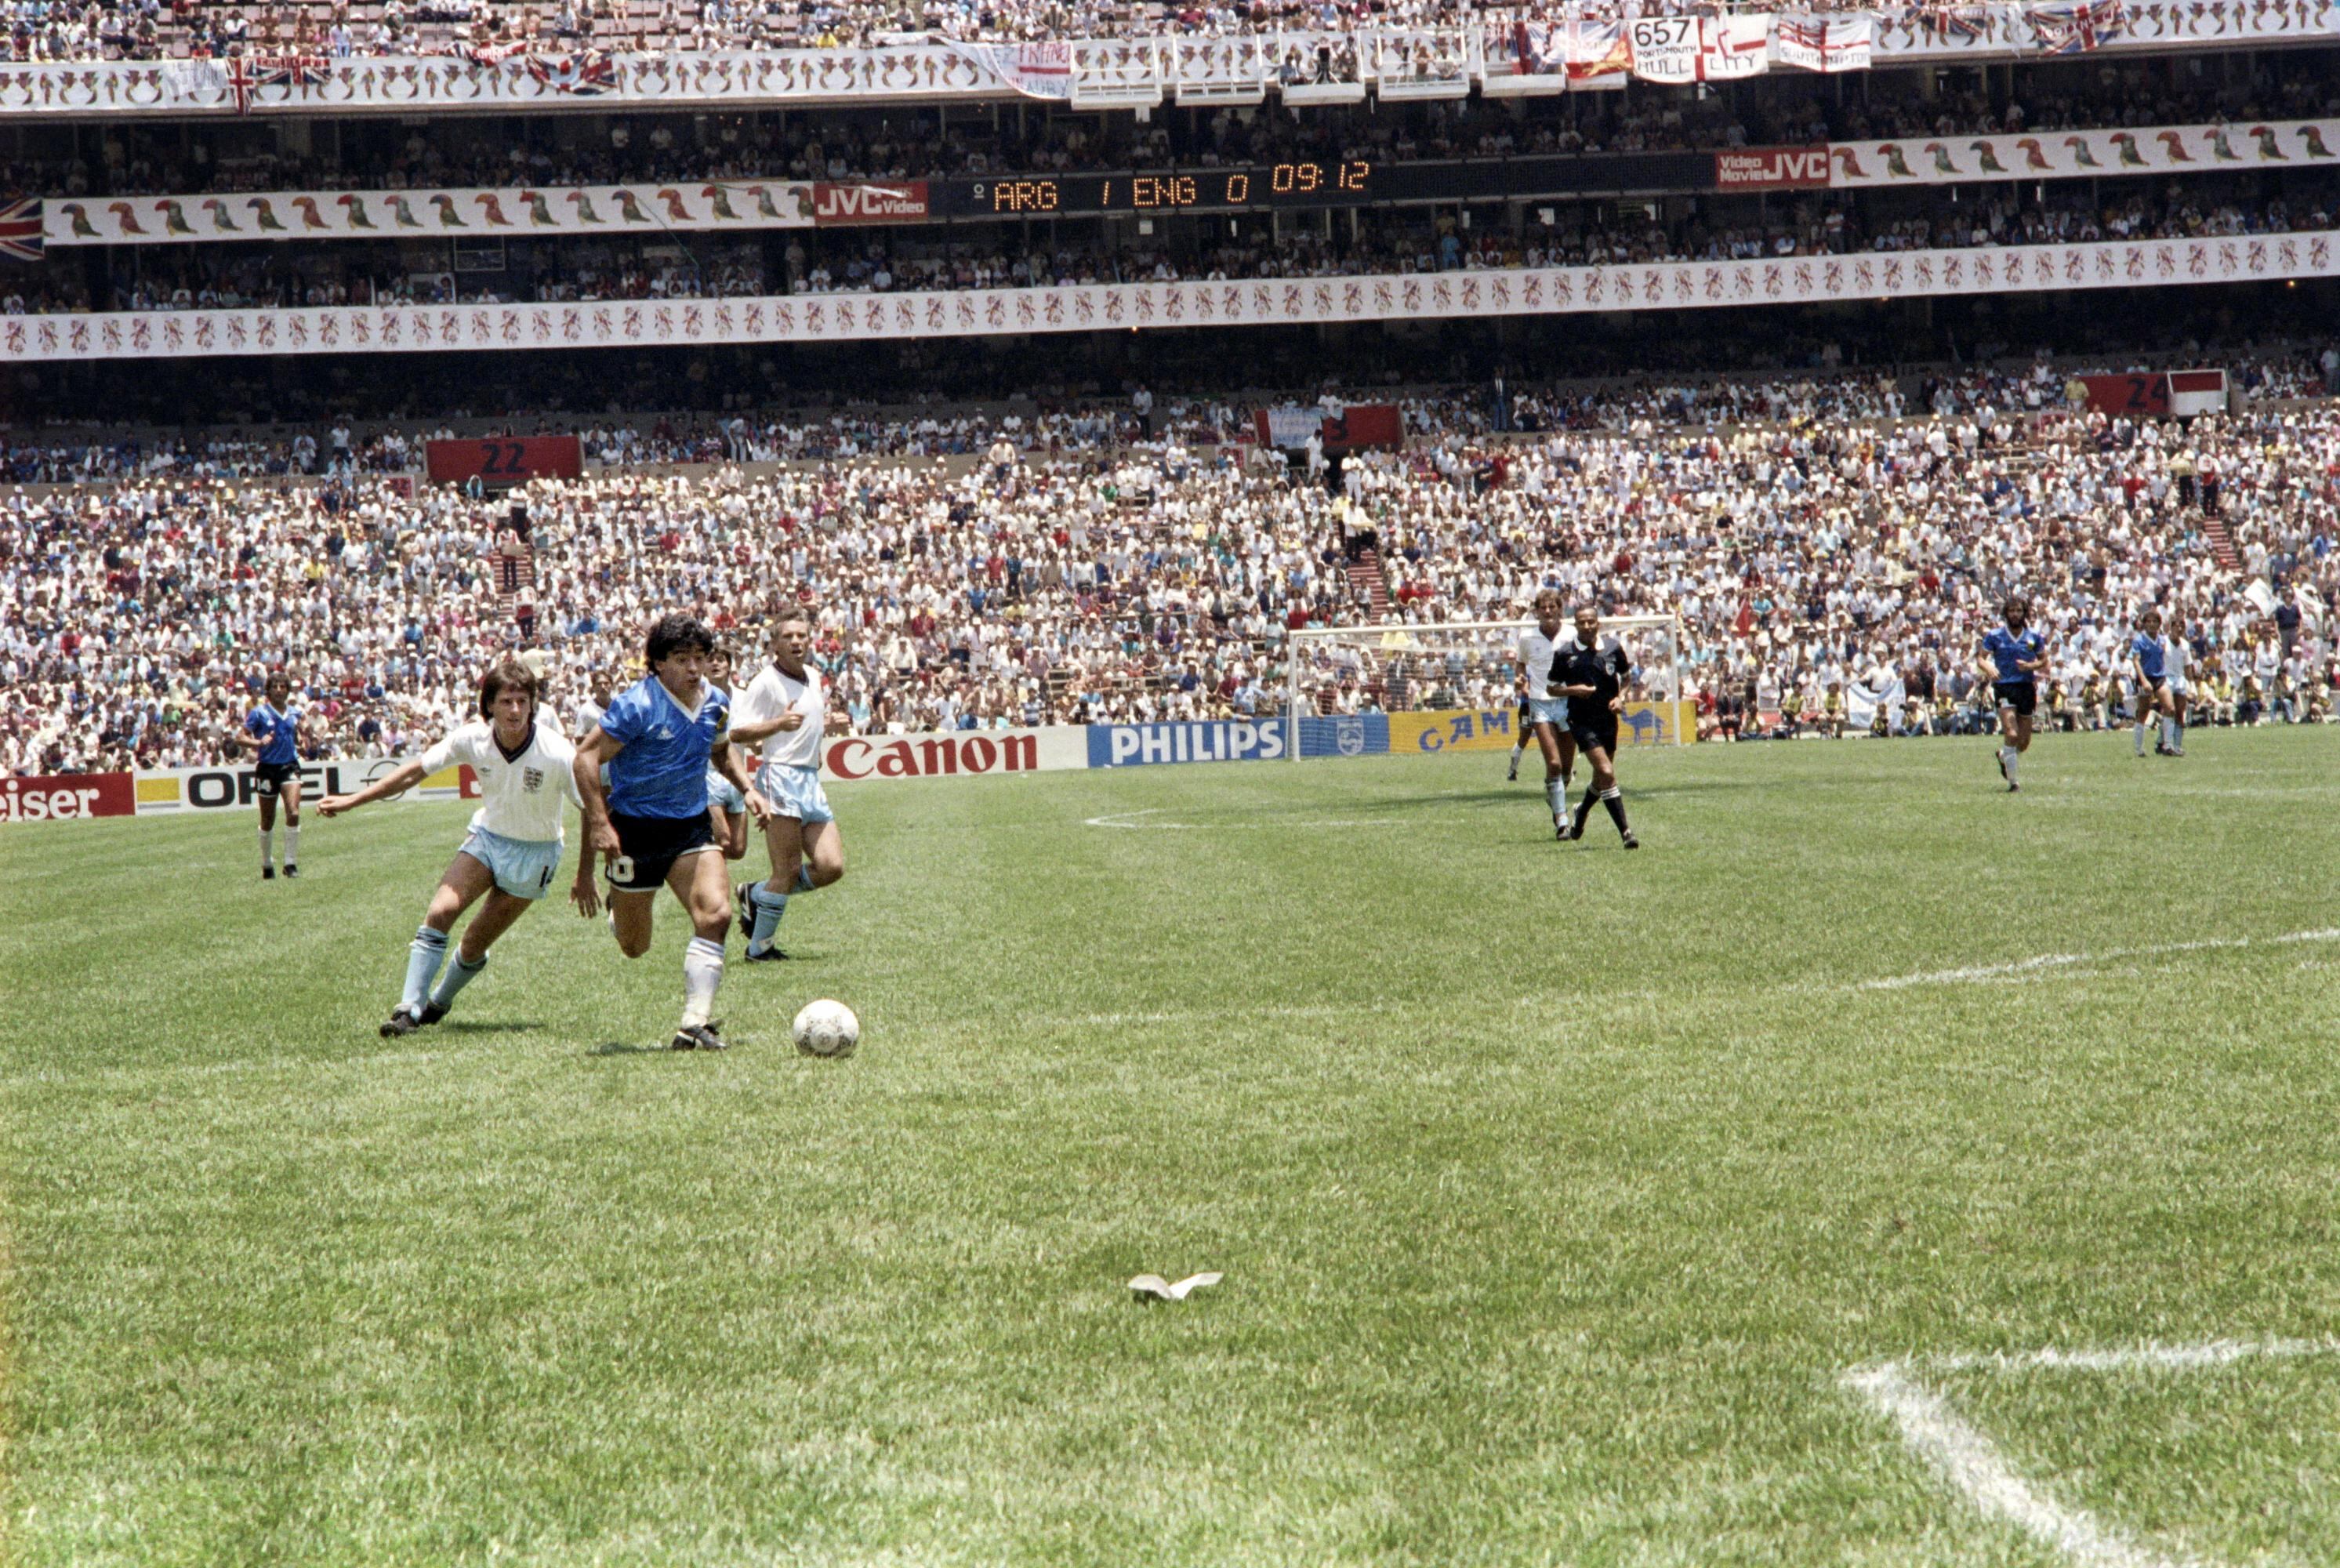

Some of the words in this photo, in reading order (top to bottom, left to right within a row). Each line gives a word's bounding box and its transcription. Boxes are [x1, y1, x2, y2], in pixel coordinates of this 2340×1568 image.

[1634, 19, 1690, 46] 657
[1637, 45, 1696, 58] PORTSMOUTH
[1638, 57, 1691, 74] HULL
[1710, 53, 1756, 71] CITY
[1720, 155, 1762, 169] Video
[1720, 167, 1764, 182] Movie
[1764, 152, 1827, 180] JVC
[818, 187, 882, 216] JVC
[883, 199, 925, 214] Video
[994, 182, 1058, 211] ARG
[1103, 181, 1109, 205] 1
[1134, 176, 1196, 205] ENG
[1227, 174, 1248, 202] 0
[2128, 376, 2168, 408] 24
[481, 443, 526, 474] 22
[826, 735, 1038, 779] Canon
[1112, 720, 1282, 764] PHILIPS
[0, 780, 100, 822] iser
